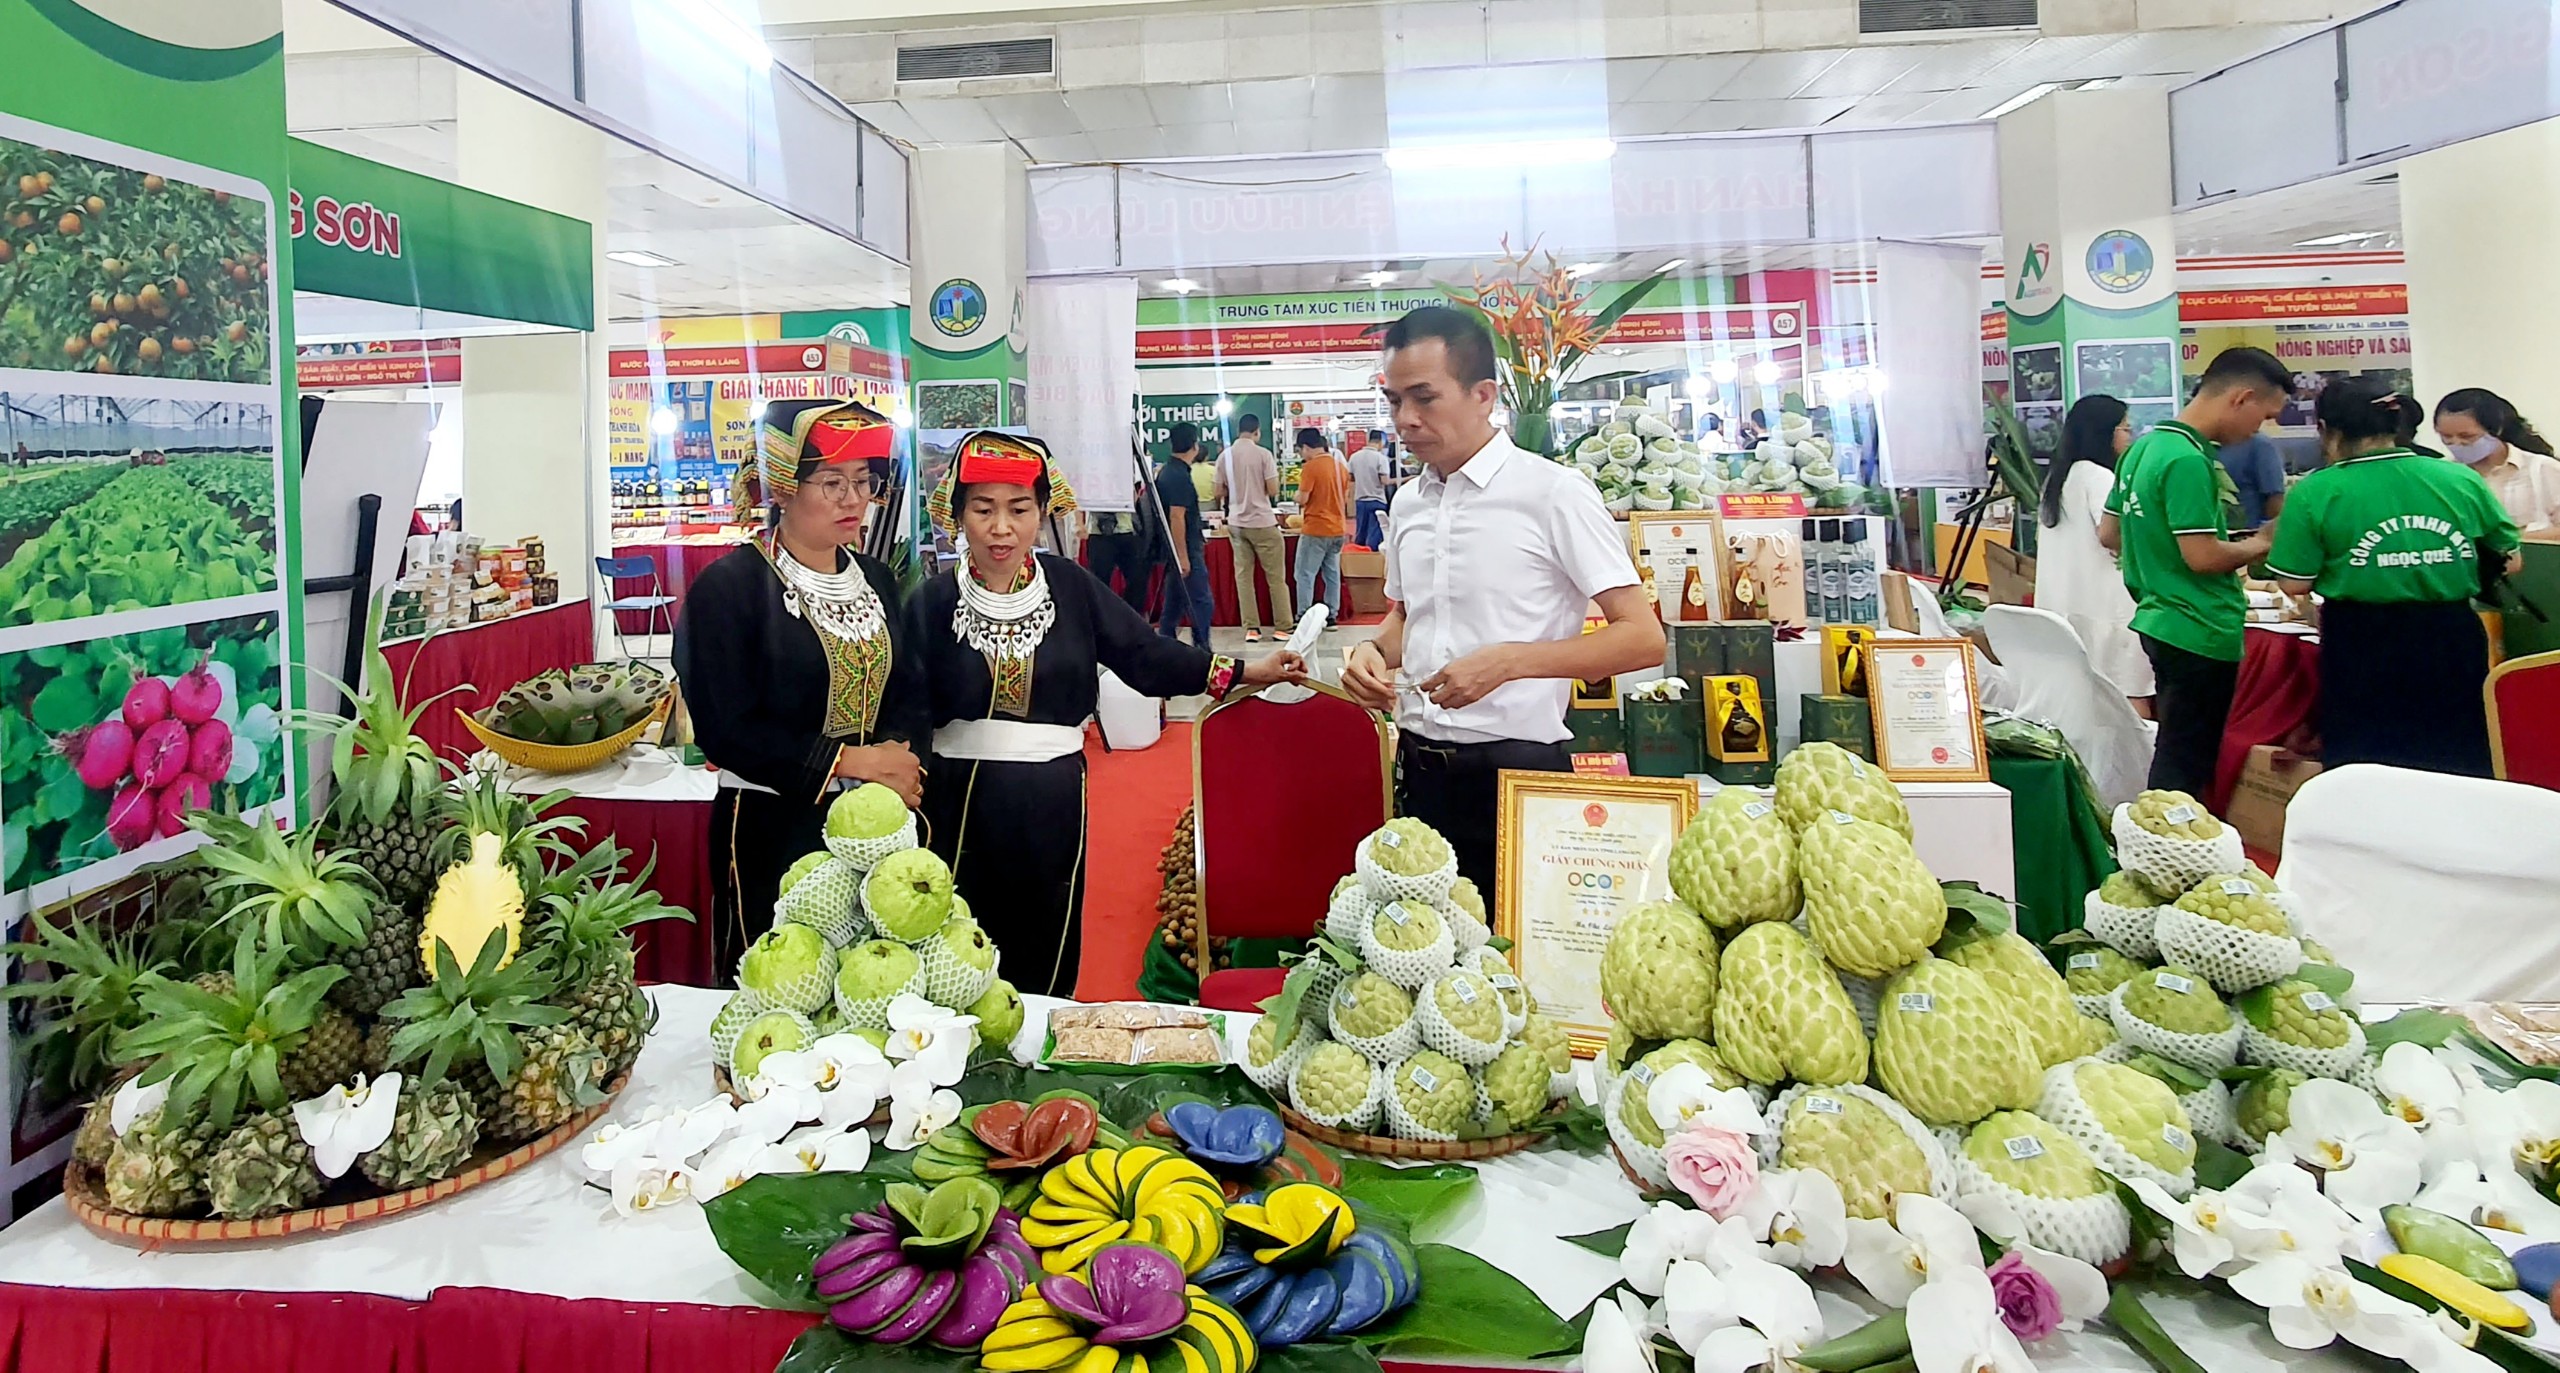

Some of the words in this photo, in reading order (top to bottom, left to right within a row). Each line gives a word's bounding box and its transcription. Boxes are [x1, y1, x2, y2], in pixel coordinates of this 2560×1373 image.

[315, 200, 400, 257] SƠN
[1219, 305, 1269, 317] TRUNG
[1274, 302, 1304, 316] TÂM
[1309, 298, 1338, 315] XÚC
[1345, 297, 1376, 313] TIẾN
[1381, 296, 1442, 312] THƯƠNG
[1777, 319, 1793, 330] A57
[2275, 338, 2312, 358] NÔNG
[2316, 335, 2364, 358] NGHIỆP
[2368, 335, 2386, 355] VÀ
[806, 354, 820, 363] A53
[1161, 403, 1218, 424] THIỆU
[2349, 530, 2383, 566] CÔNG
[2378, 518, 2400, 535] TY
[2400, 515, 2452, 536] TNHH
[2376, 551, 2422, 568] NGỌC
[1567, 871, 1626, 891] OCOP
